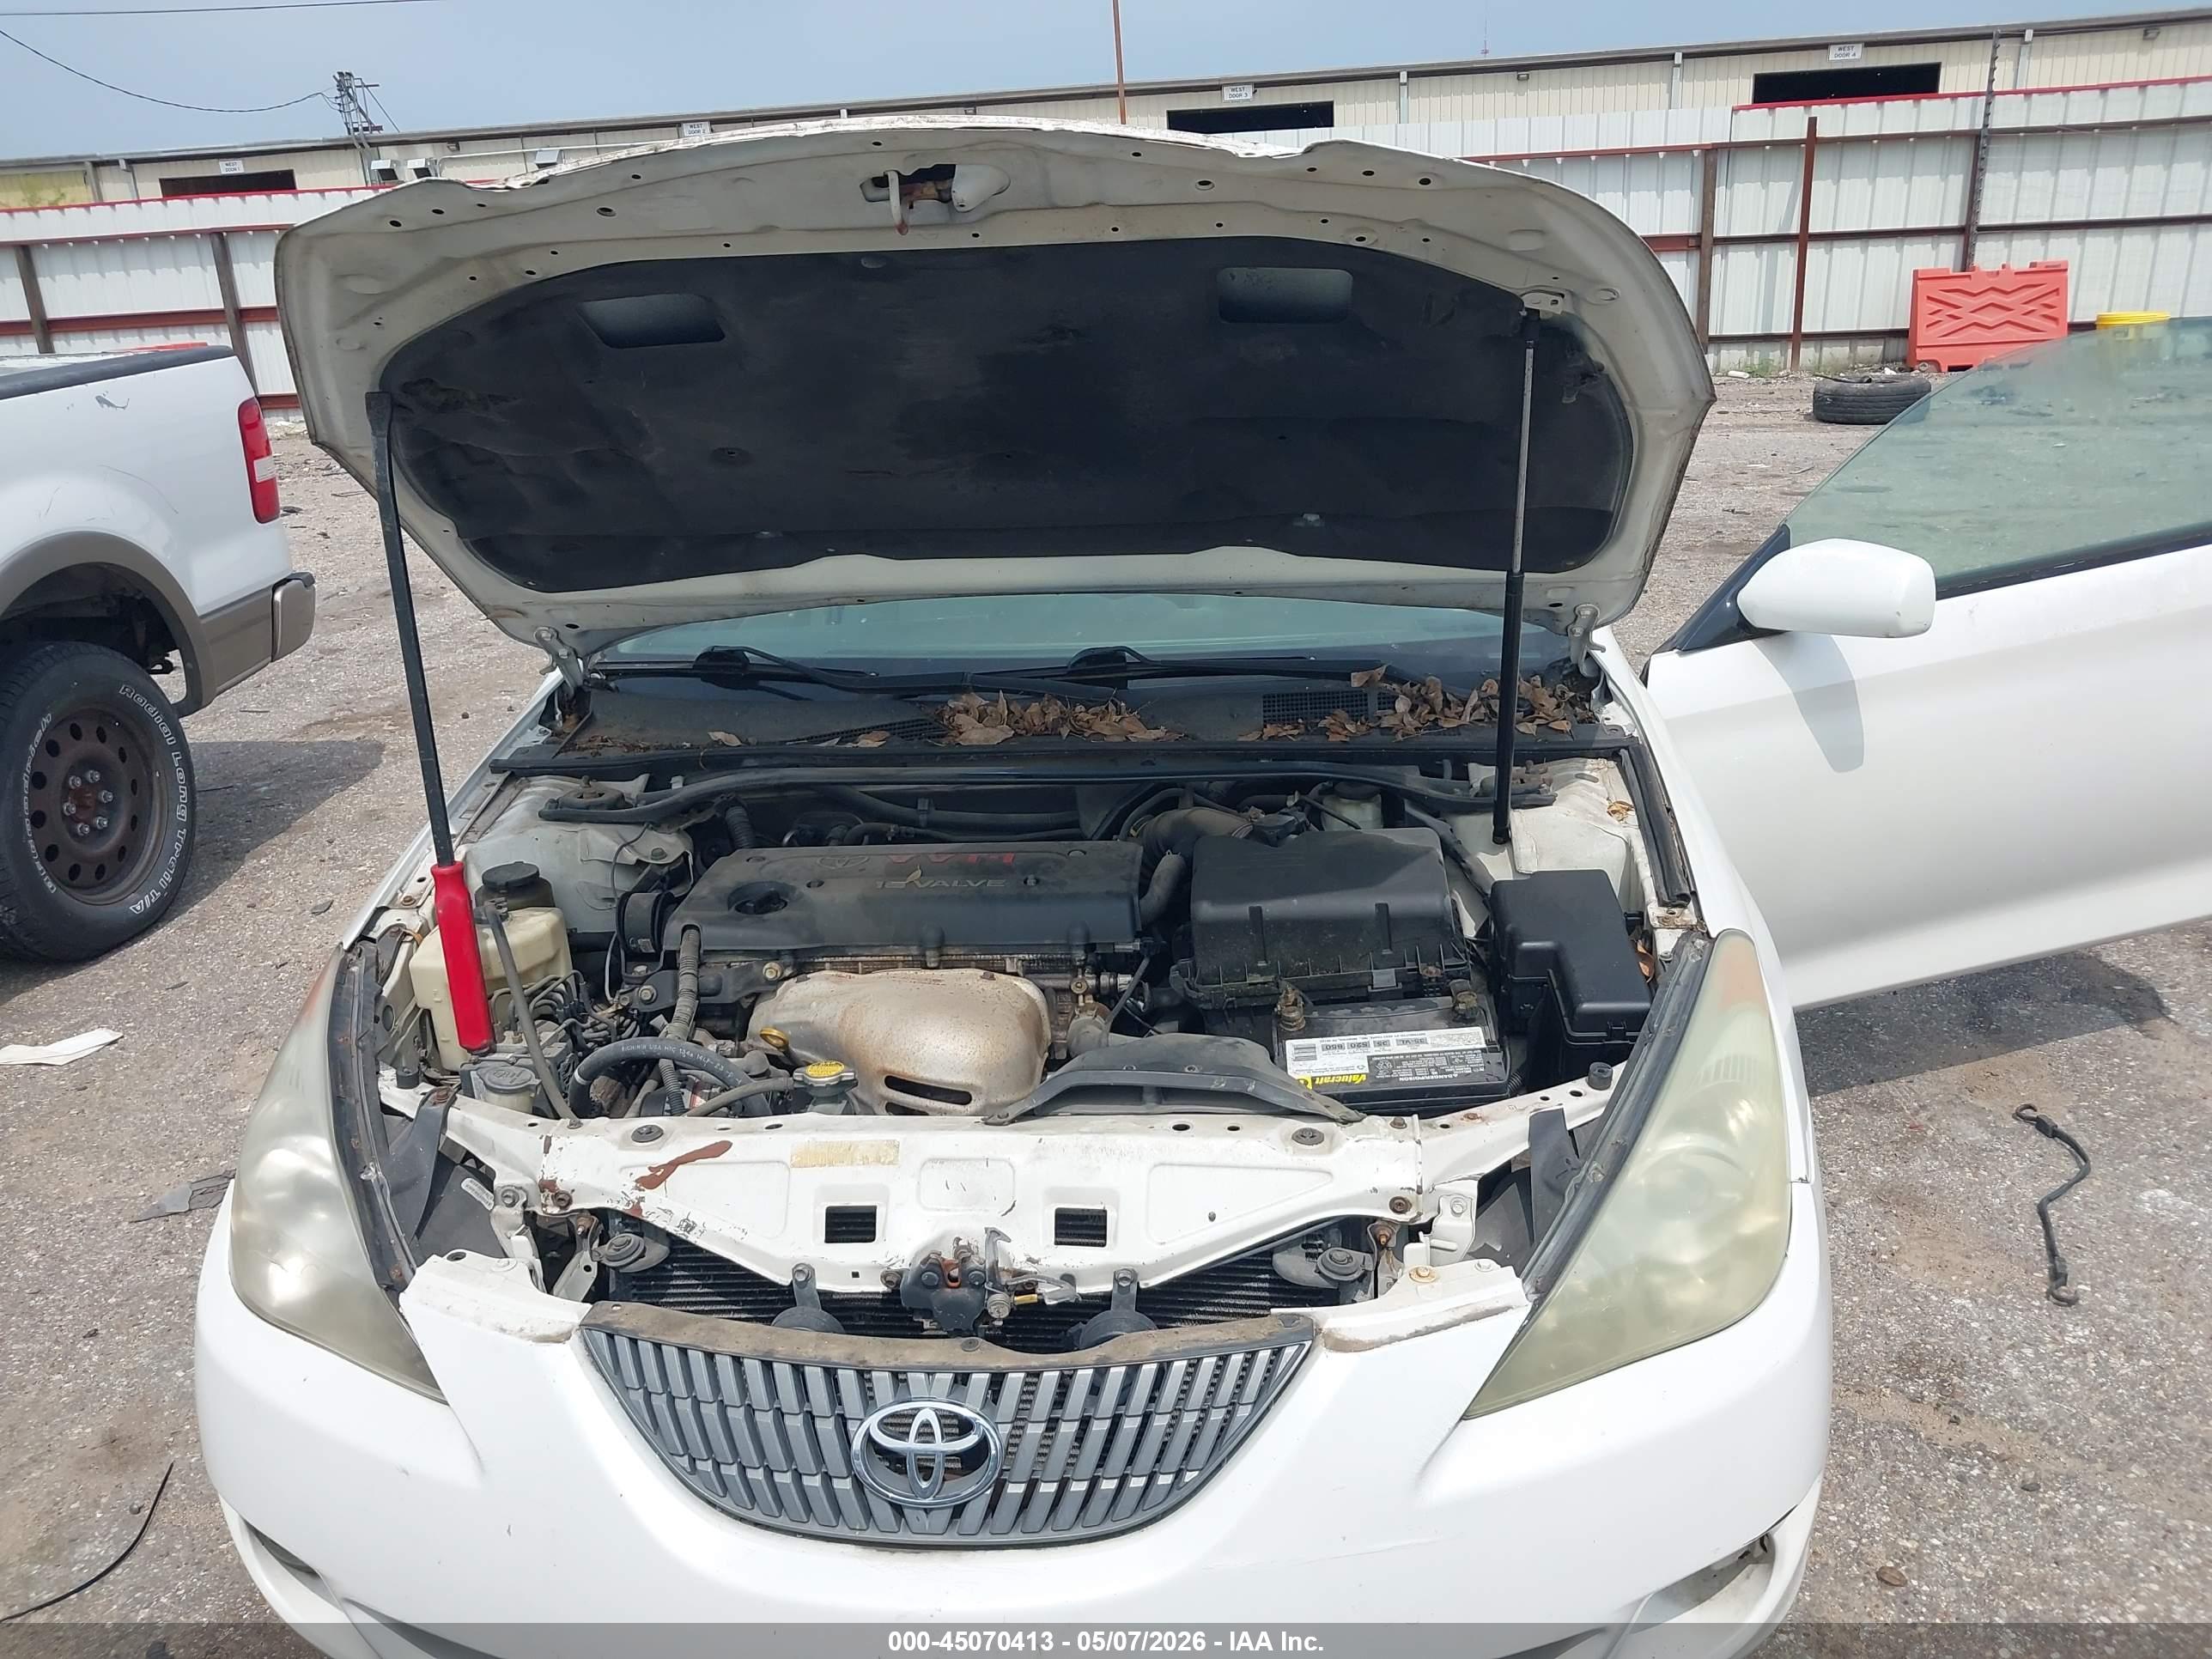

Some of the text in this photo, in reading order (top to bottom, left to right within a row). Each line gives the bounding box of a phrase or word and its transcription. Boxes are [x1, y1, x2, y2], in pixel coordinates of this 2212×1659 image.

[119, 684, 187, 915] Radial Long Trail T/A
[913, 879, 1007, 889] VALVE
[1315, 1073, 1367, 1085] Valucraft
